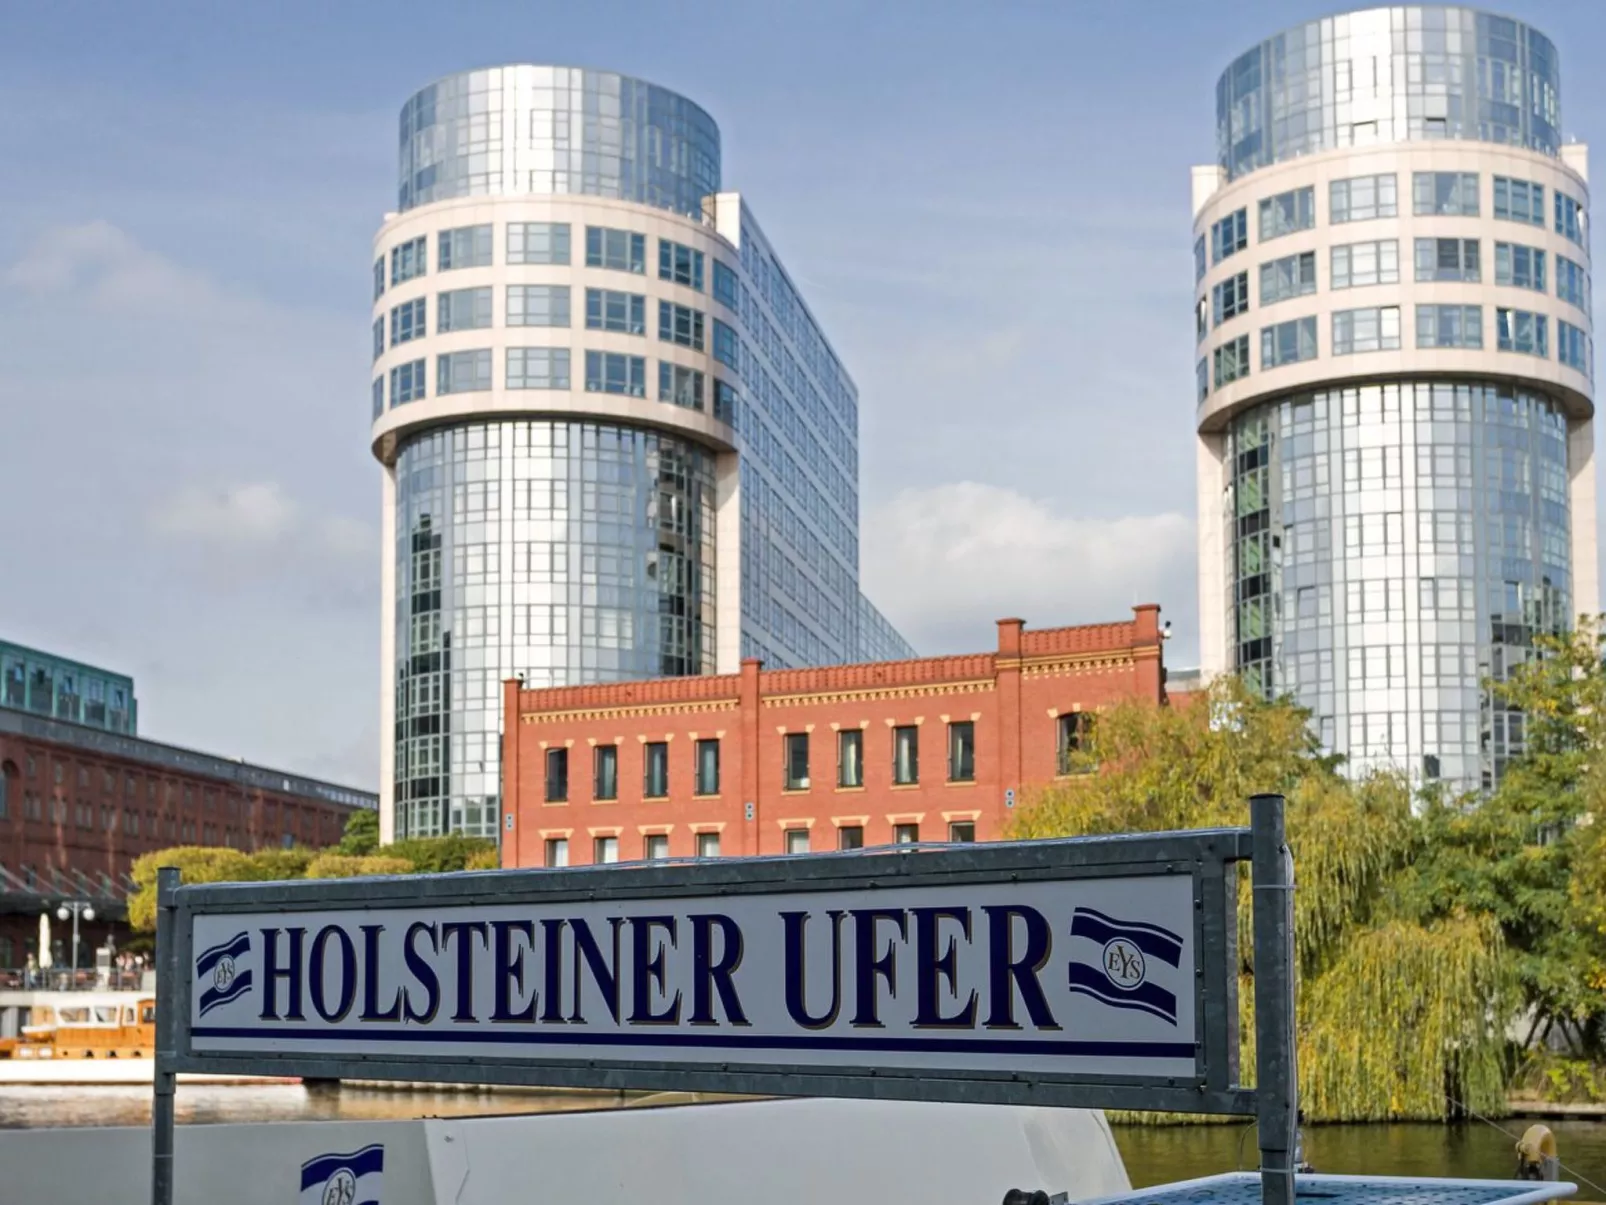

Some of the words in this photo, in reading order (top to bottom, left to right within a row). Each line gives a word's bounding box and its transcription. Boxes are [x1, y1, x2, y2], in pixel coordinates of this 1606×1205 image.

[259, 914, 752, 1027] HOLSTEINER
[778, 905, 1063, 1031] UFER
[1108, 944, 1140, 979] EYS
